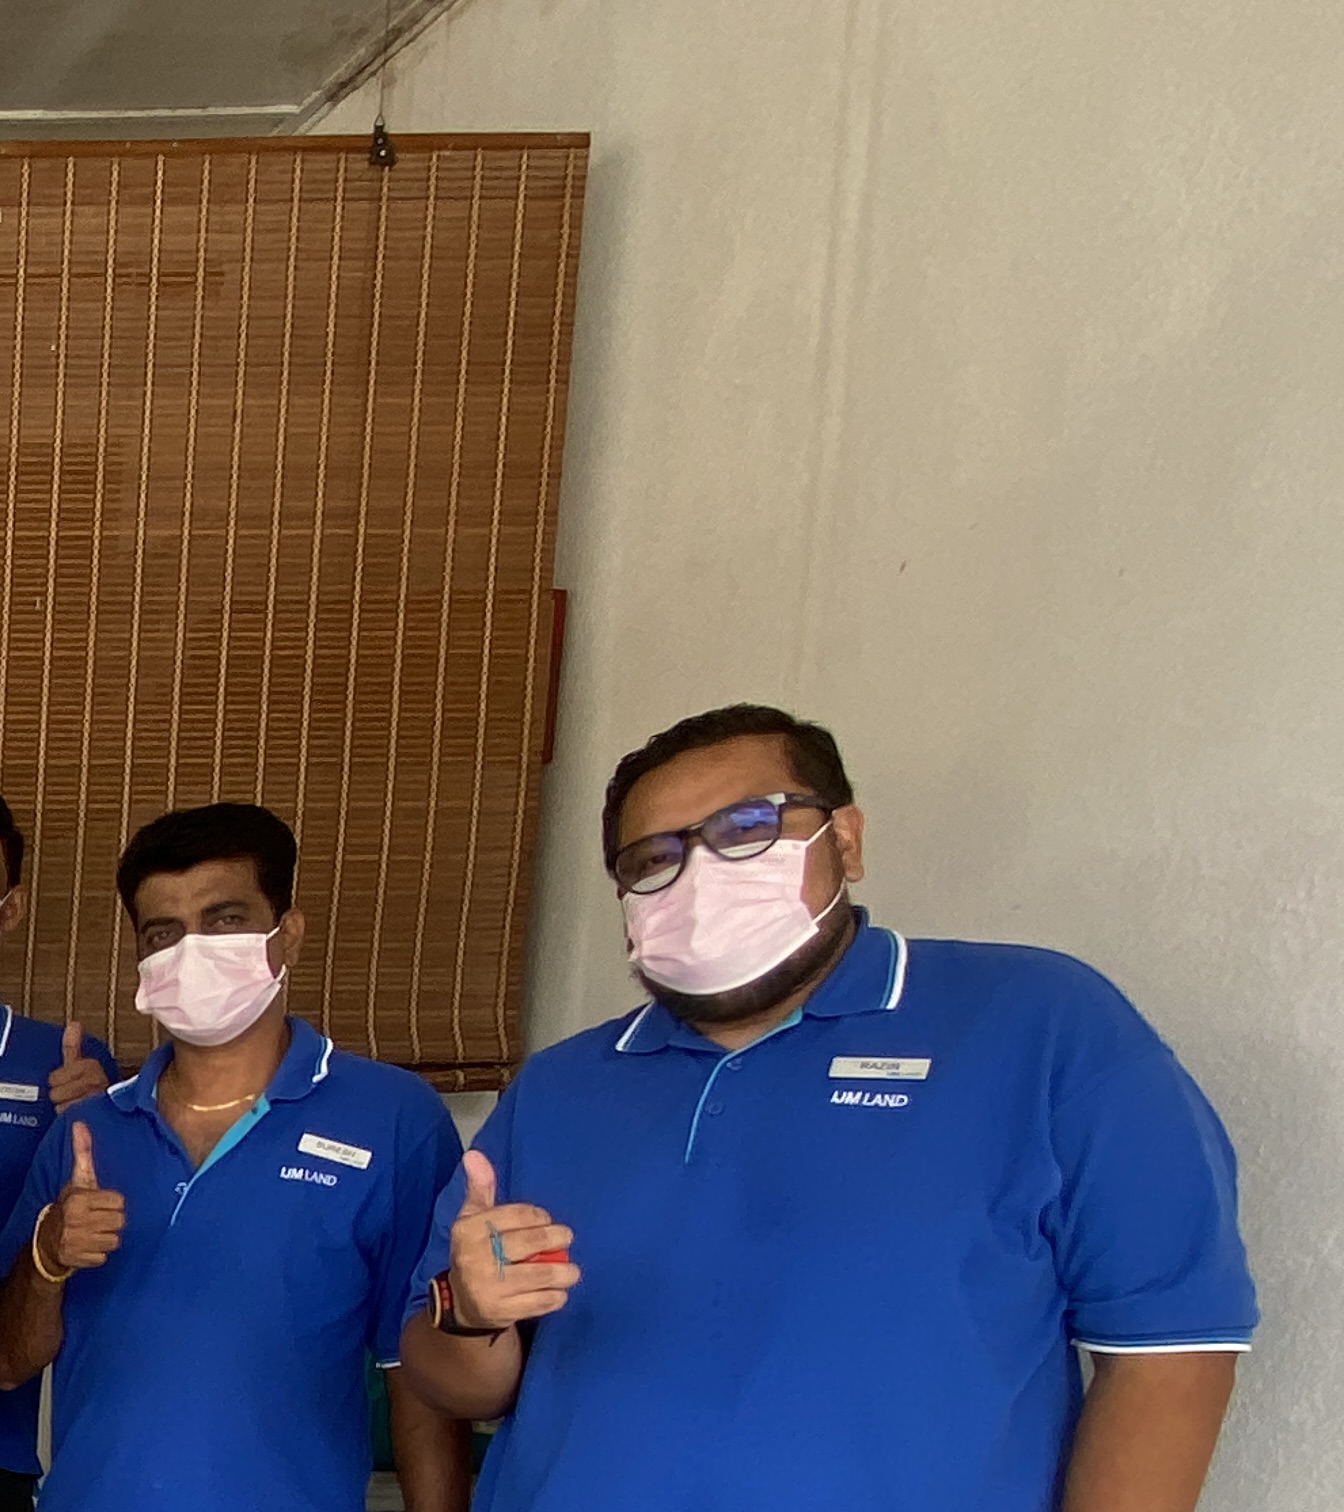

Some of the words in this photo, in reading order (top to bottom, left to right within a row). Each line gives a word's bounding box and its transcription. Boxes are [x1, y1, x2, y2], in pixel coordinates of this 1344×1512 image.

[830, 1090, 862, 1105] IJM
[862, 1092, 909, 1107] LAND
[13, 1113, 38, 1127] LAND
[280, 1166, 304, 1180] IJM
[304, 1168, 338, 1187] LAND
